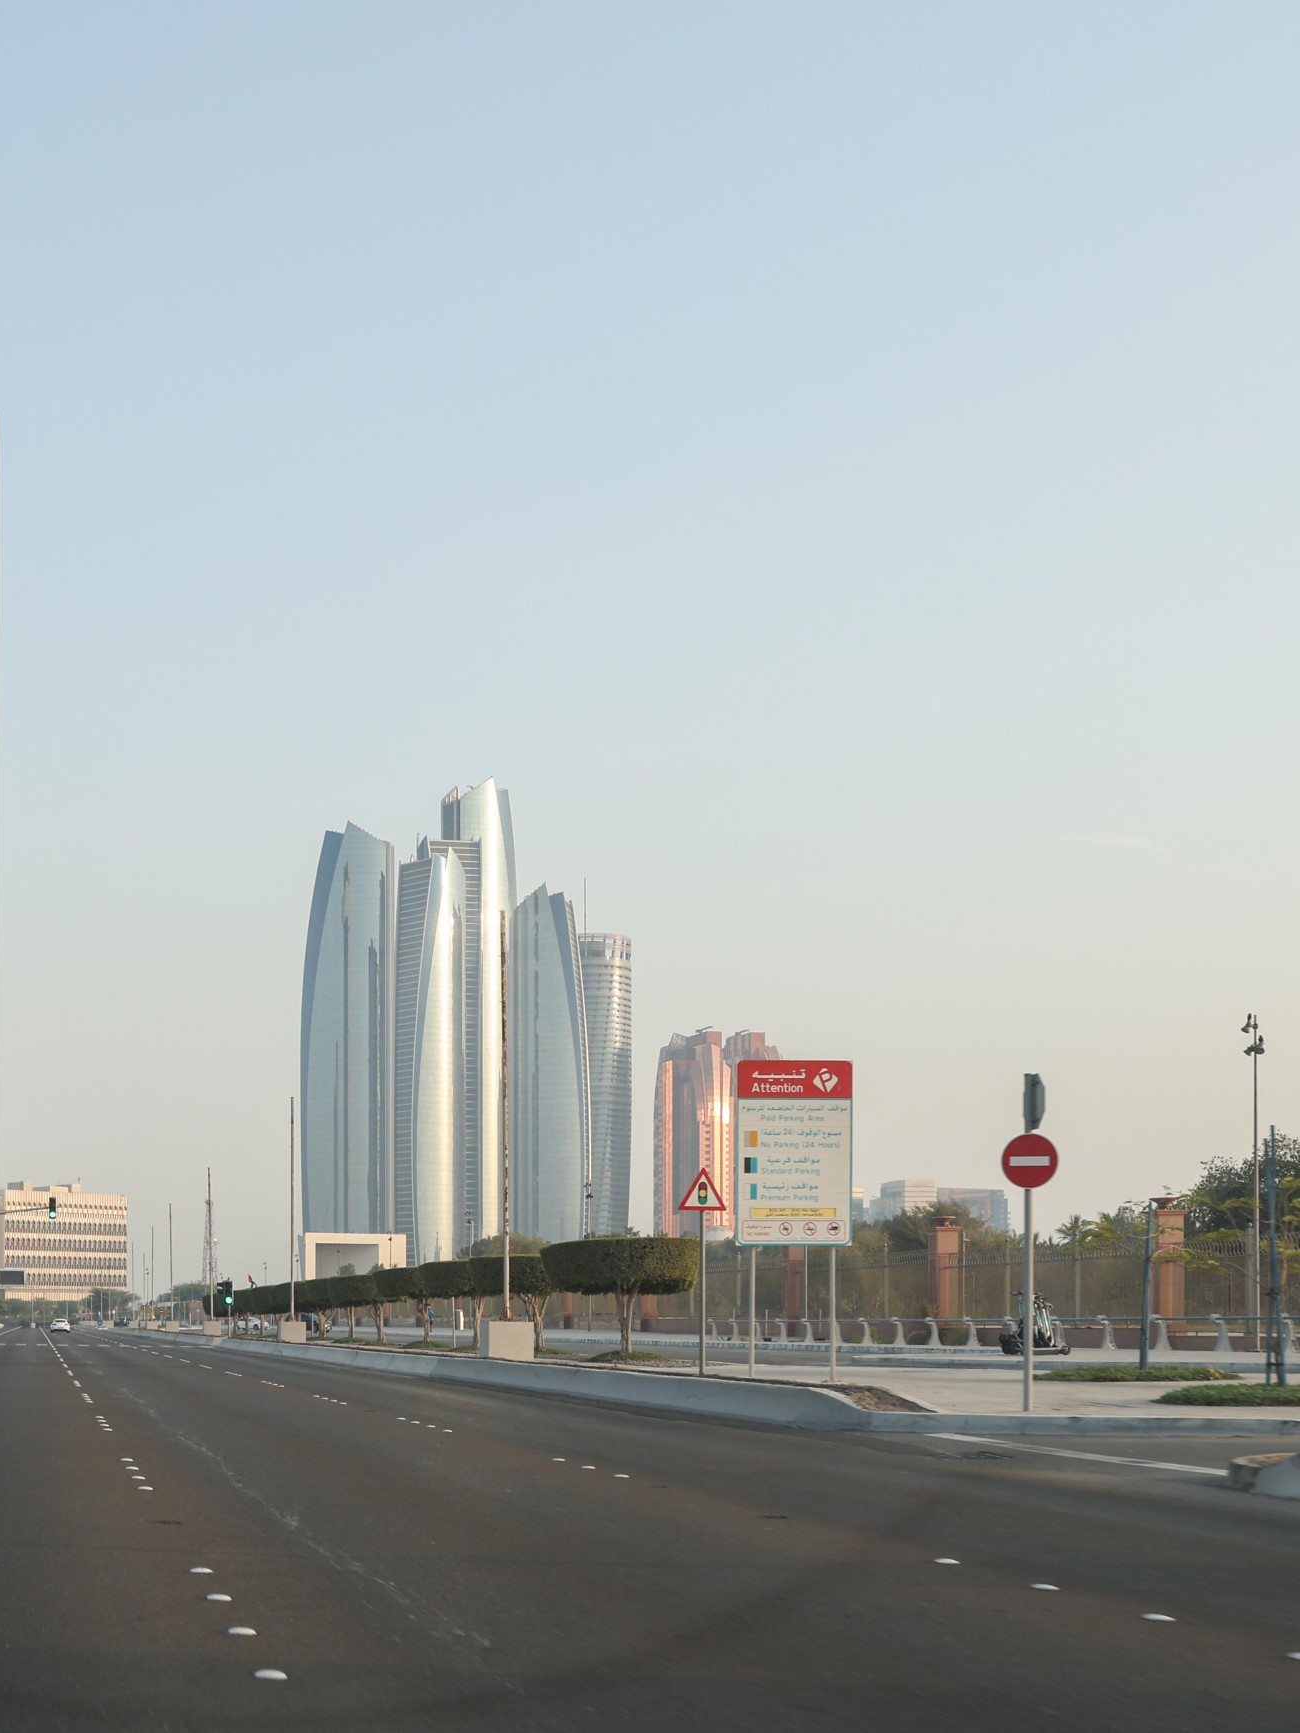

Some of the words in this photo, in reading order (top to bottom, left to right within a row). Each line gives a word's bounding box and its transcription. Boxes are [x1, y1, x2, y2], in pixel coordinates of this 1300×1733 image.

[751, 1069, 806, 1082] تنبيه
[751, 1082, 804, 1093] Attention
[761, 1114, 776, 1122] Paid
[779, 1114, 804, 1123] Parking
[807, 1114, 825, 1122] Area
[774, 1141, 800, 1149] Parking
[766, 1155, 791, 1165] فرعية
[792, 1155, 820, 1165] مواقف
[794, 1167, 820, 1176] Parking
[791, 1181, 819, 1191] مواقف
[793, 1194, 819, 1203] Parking
